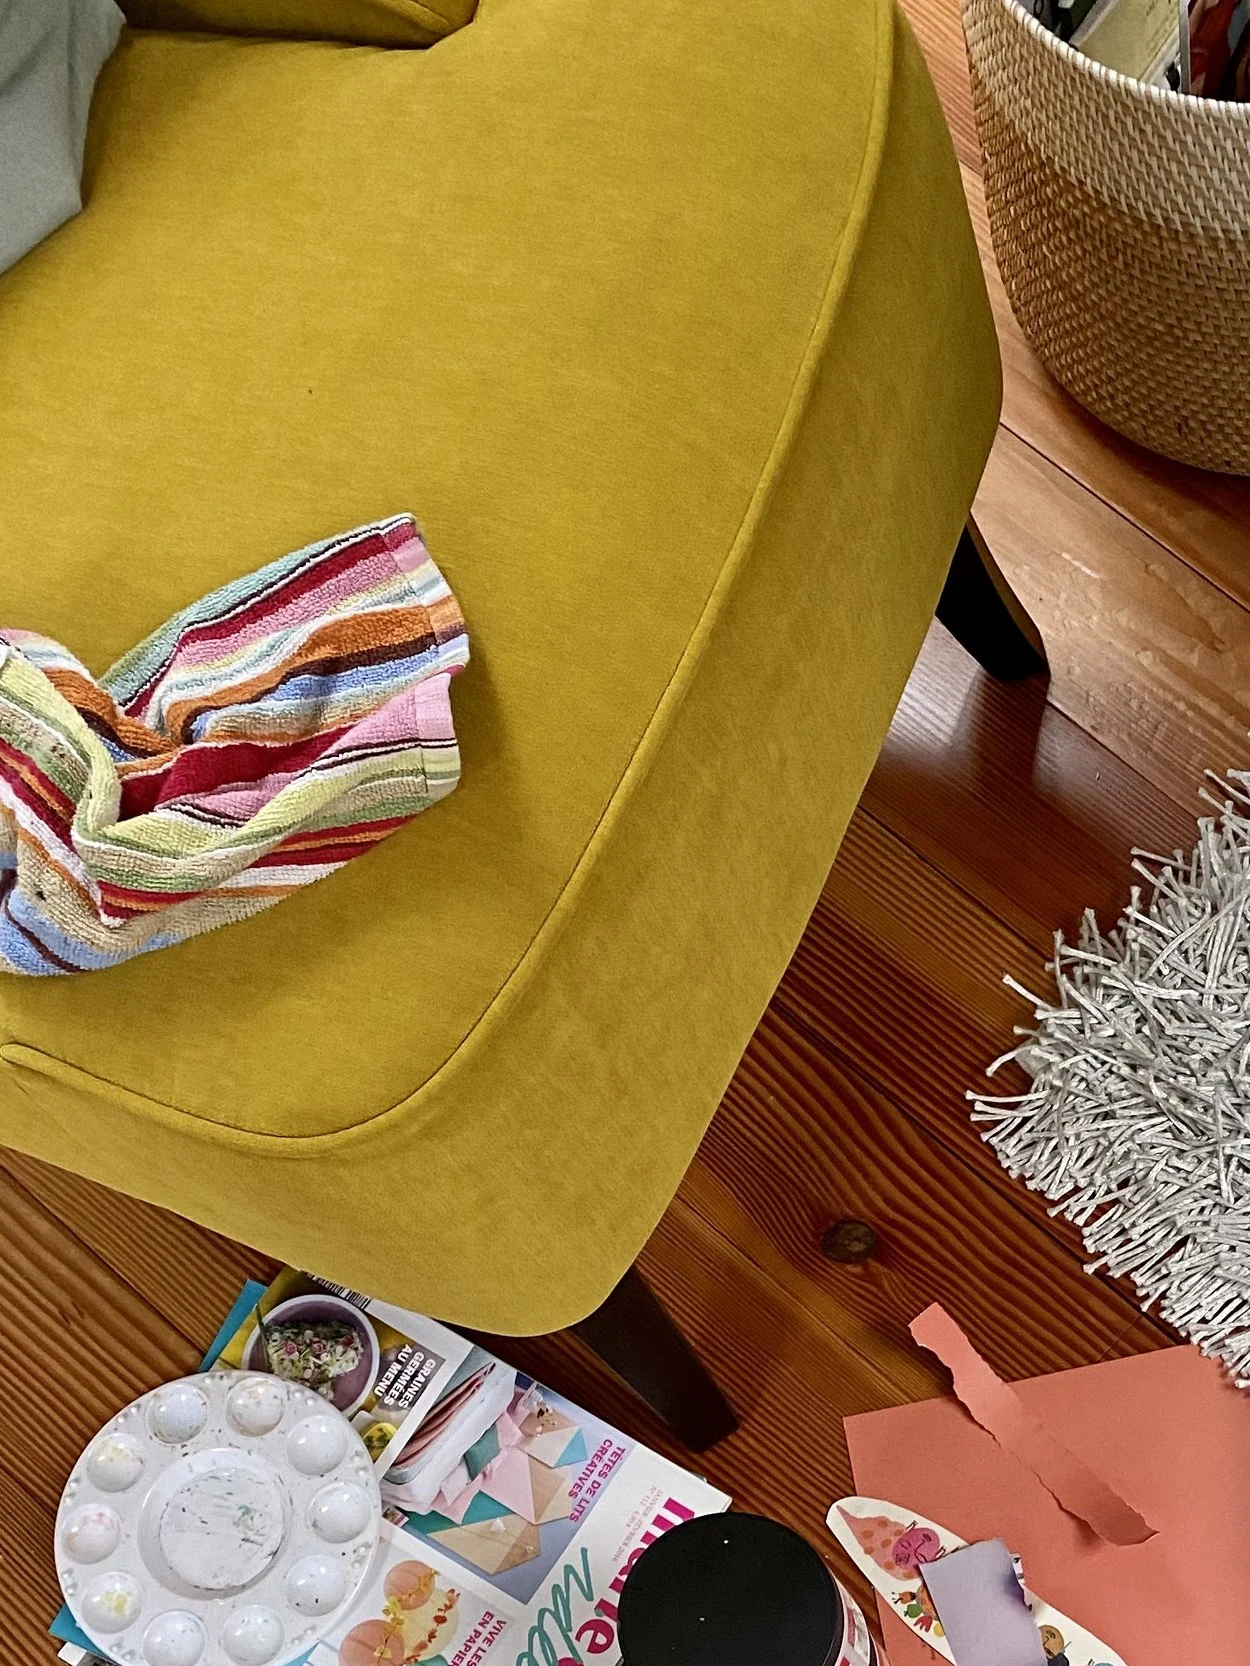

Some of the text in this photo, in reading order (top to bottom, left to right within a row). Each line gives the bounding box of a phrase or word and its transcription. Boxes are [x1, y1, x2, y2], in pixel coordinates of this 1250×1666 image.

[372, 1342, 413, 1399] AU MENU
[381, 1346, 426, 1410] GERMÉES
[396, 1354, 437, 1412] GRAINES
[565, 1433, 615, 1504] CRÉATIVES
[567, 1441, 625, 1523] TÊTES DE LITS
[476, 1609, 494, 1630] EN
[480, 1614, 506, 1647] VIVE
